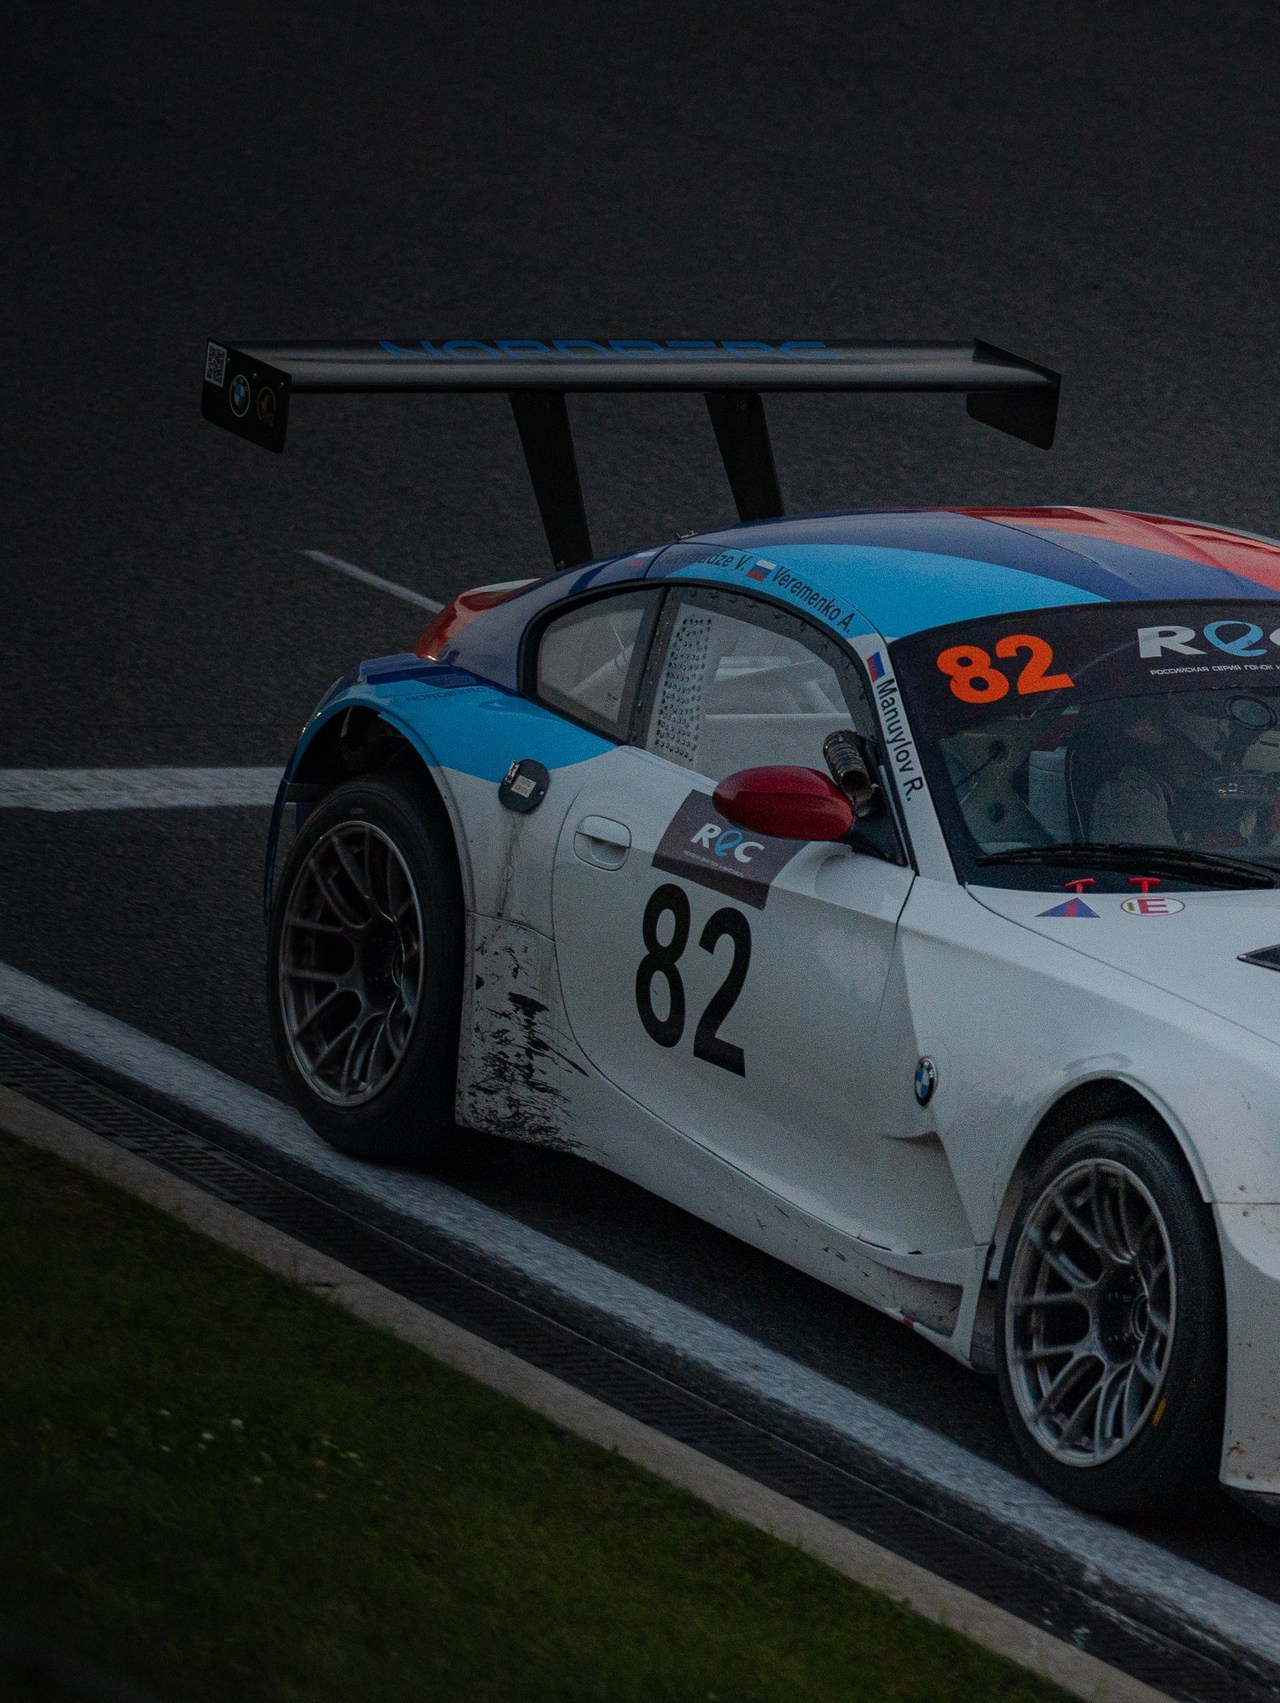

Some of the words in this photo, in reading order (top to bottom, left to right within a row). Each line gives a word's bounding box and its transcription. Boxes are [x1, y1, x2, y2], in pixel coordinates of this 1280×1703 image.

[771, 565, 842, 622] Veremenko
[839, 612, 857, 633] A.
[936, 633, 1076, 704] 82
[1149, 666, 1210, 676] РОССИЙСКАЯ
[1211, 664, 1242, 672] СЕРИЯ
[876, 677, 914, 773] Manuylov
[903, 776, 925, 801] R.
[636, 883, 752, 1078] 82
